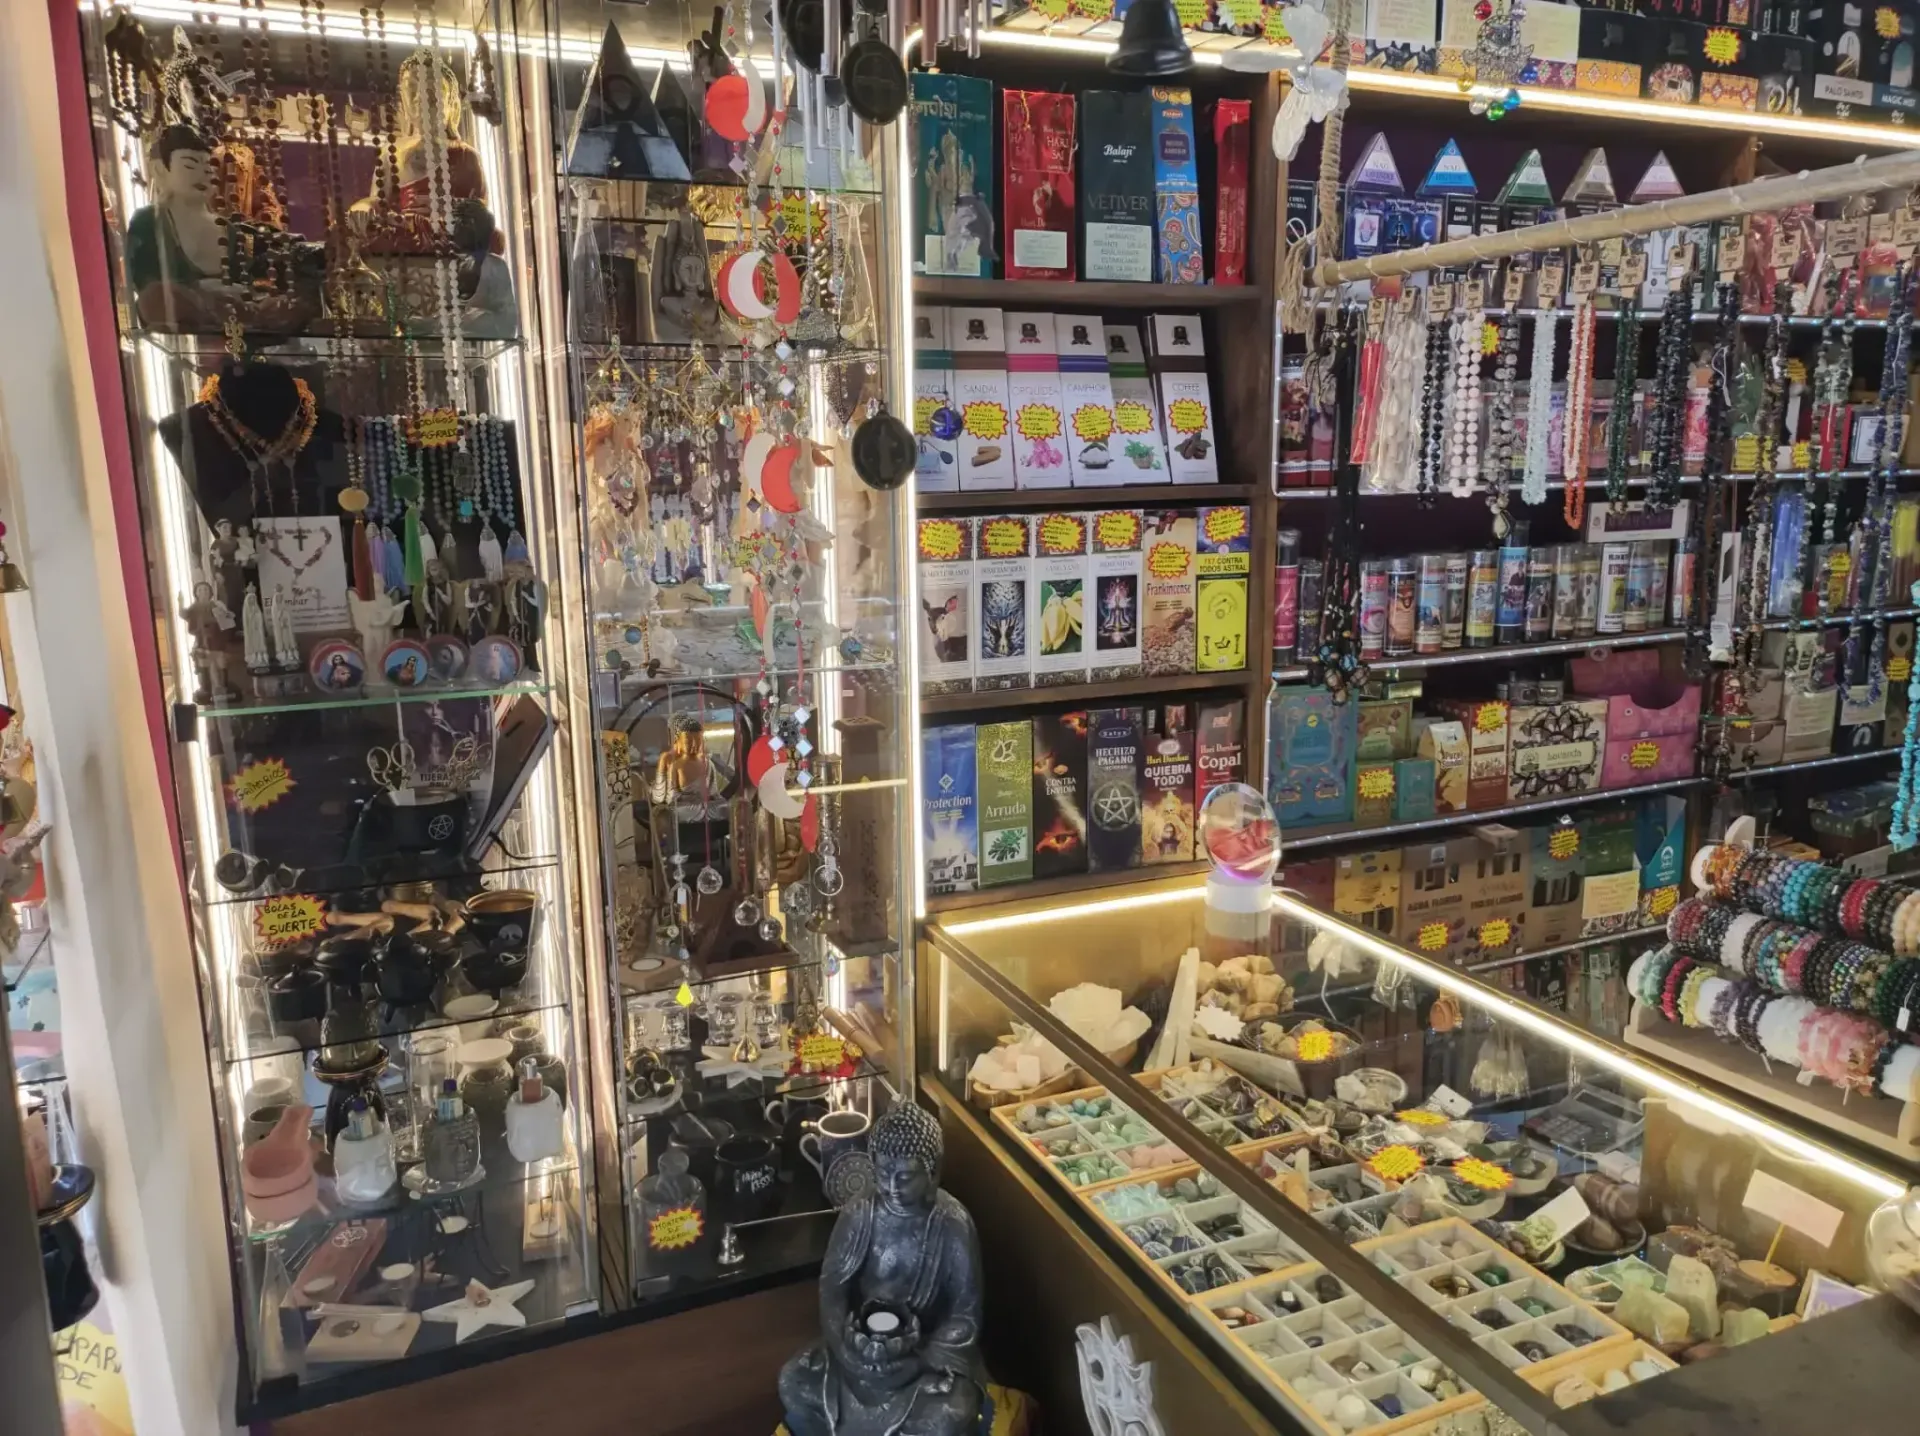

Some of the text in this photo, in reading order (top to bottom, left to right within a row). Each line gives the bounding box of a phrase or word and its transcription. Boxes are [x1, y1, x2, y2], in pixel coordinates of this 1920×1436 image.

[1104, 144, 1133, 158] Balaji
[1088, 193, 1149, 211] VETIVER
[1217, 556, 1243, 565] CONTRA
[1200, 563, 1247, 573] TODOS ASTRAL
[1146, 582, 1192, 596] Frankincense
[1096, 746, 1136, 757] HECHIZO
[1098, 755, 1134, 766] PAGANO
[1198, 752, 1242, 770] Copal
[1144, 763, 1192, 778] QUIEBRA
[1045, 776, 1077, 787] CONTRA
[1153, 775, 1184, 787] TODO
[1046, 785, 1077, 796] ENVIDIA
[923, 795, 972, 810] Protection
[985, 801, 1026, 818] Arruda
[264, 902, 297, 914] BOLAS
[277, 908, 306, 920] DE LA
[269, 918, 317, 936] SUERTE
[60, 1363, 97, 1389] DE
